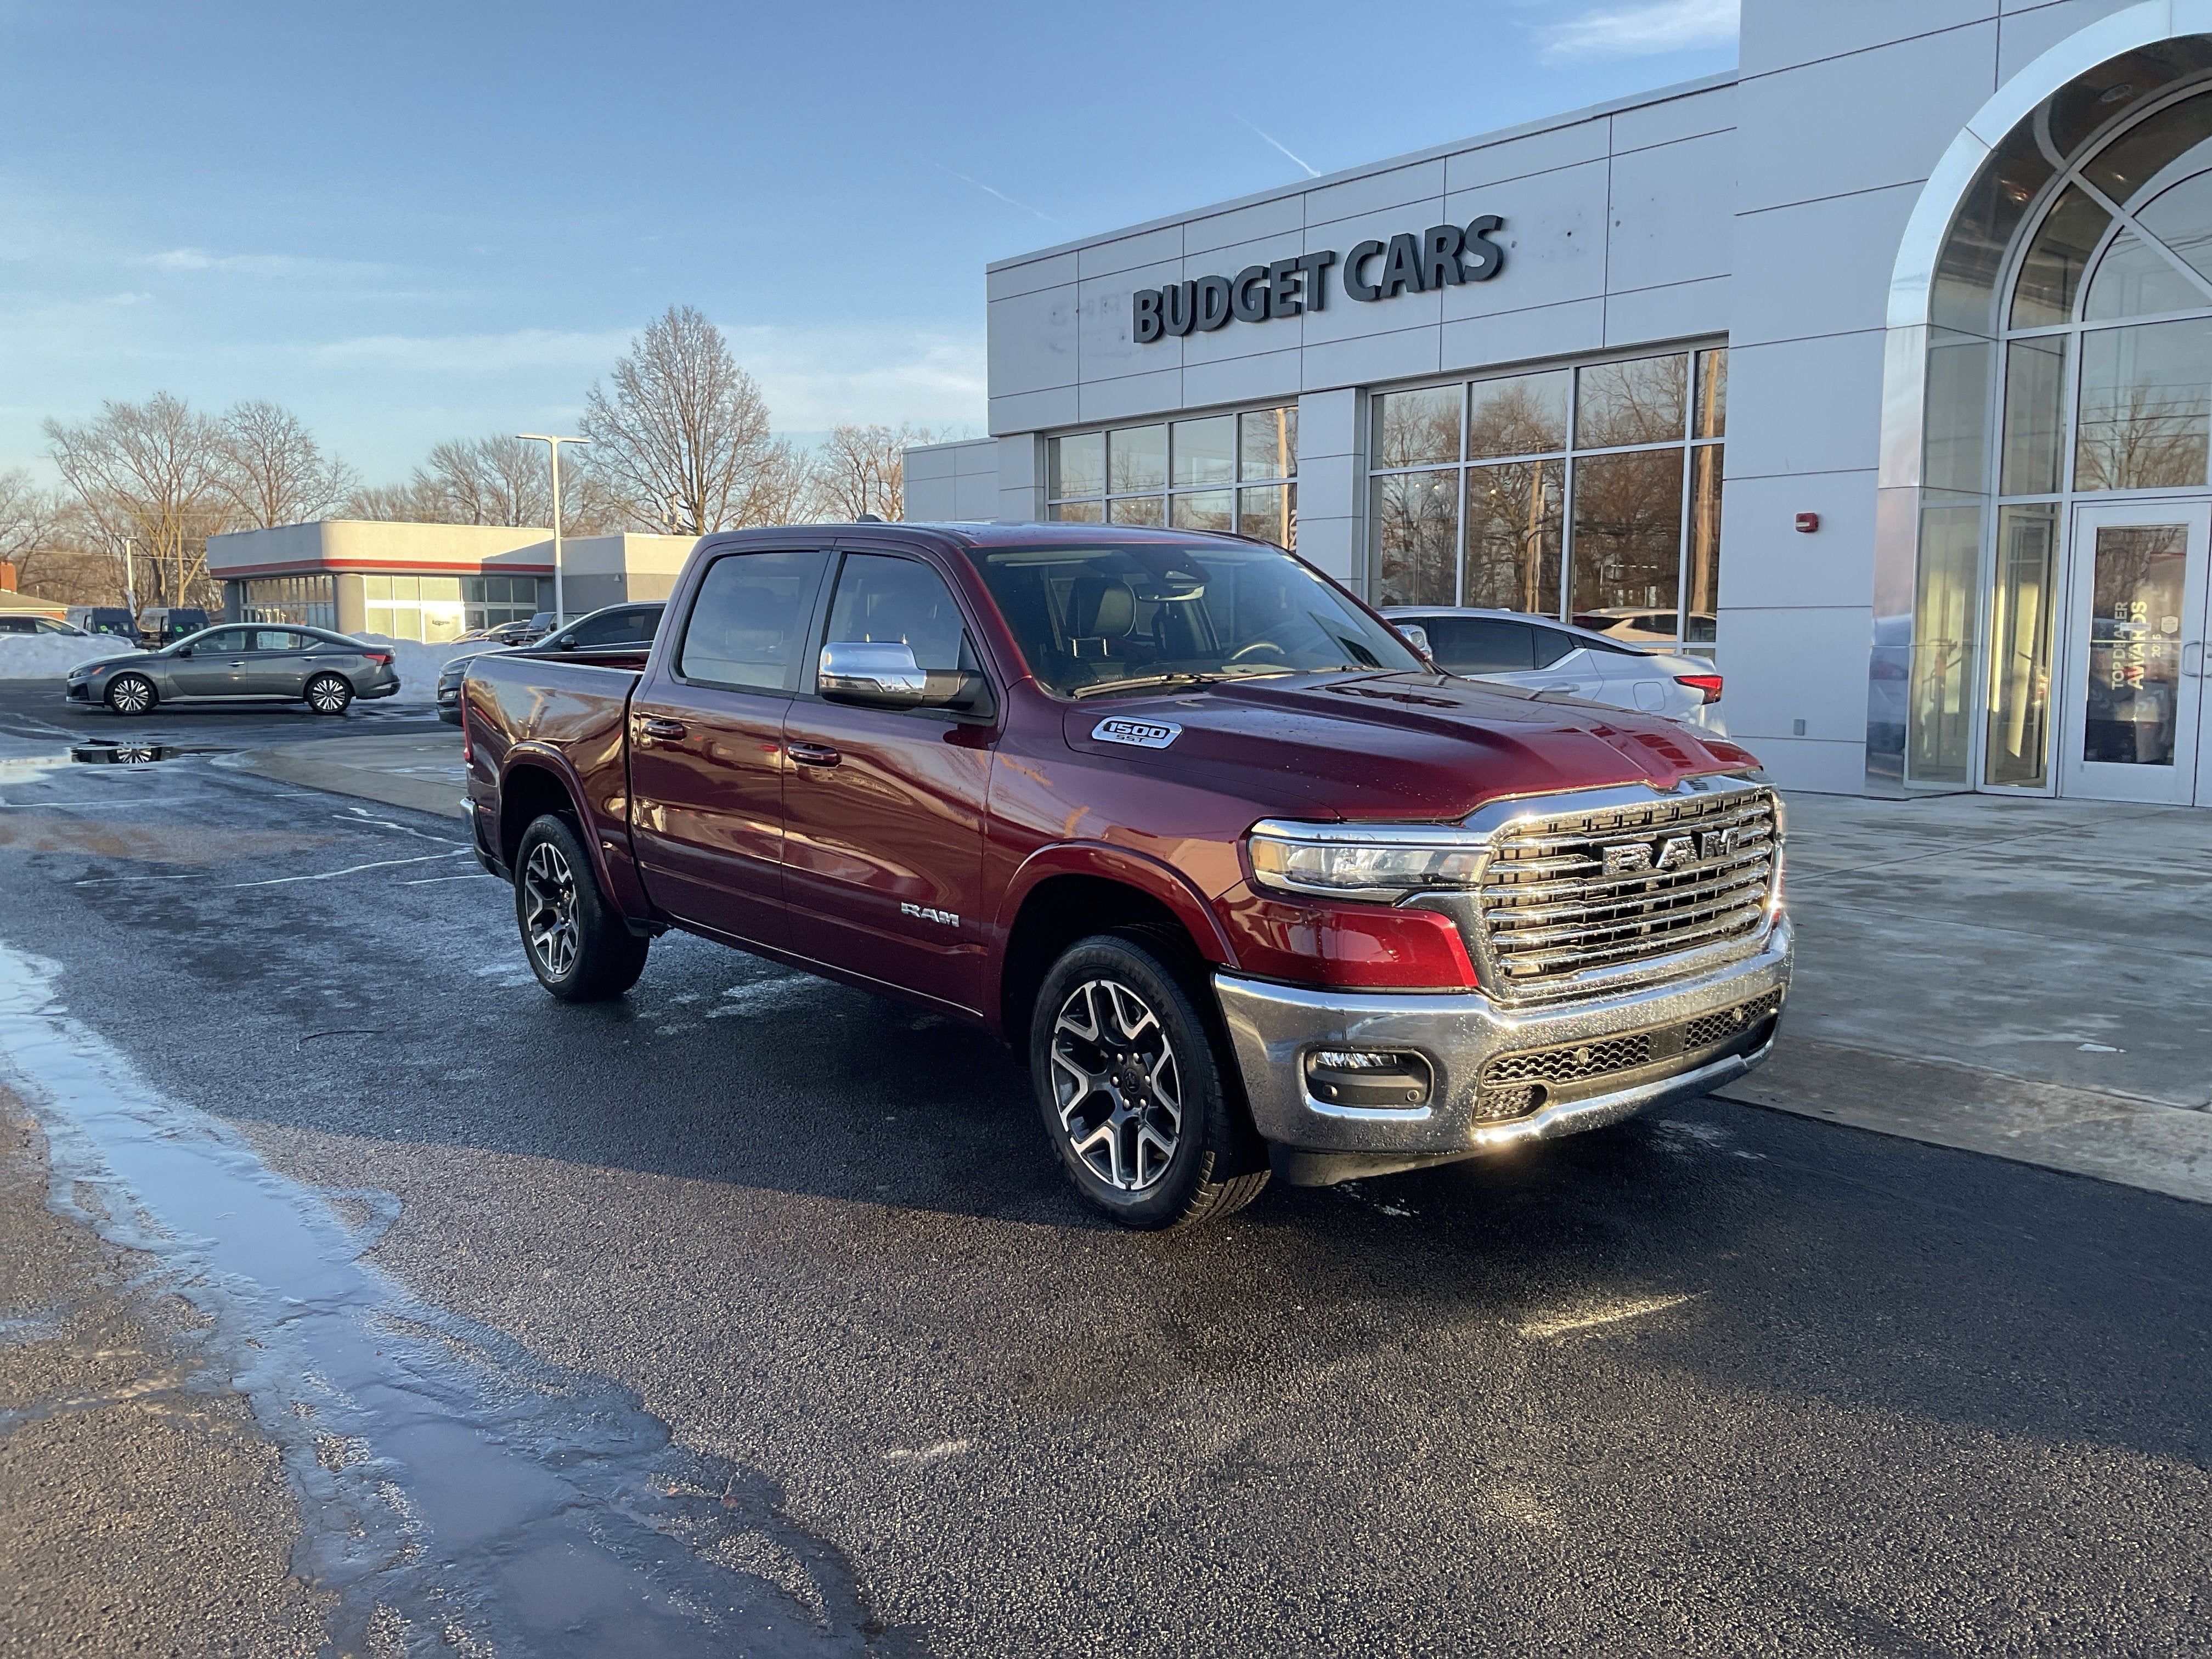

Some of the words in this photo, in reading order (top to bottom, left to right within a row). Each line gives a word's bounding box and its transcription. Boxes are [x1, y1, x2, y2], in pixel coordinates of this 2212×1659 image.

[1133, 250, 1335, 343] BUDGET
[1344, 215, 1503, 301] CARS
[2152, 634, 2162, 657] 205
[2112, 661, 2125, 690] TOP
[1109, 723, 1166, 738] 1500
[1116, 734, 1147, 742] SST
[1602, 827, 1740, 876] RAM
[901, 901, 960, 928] RAM
